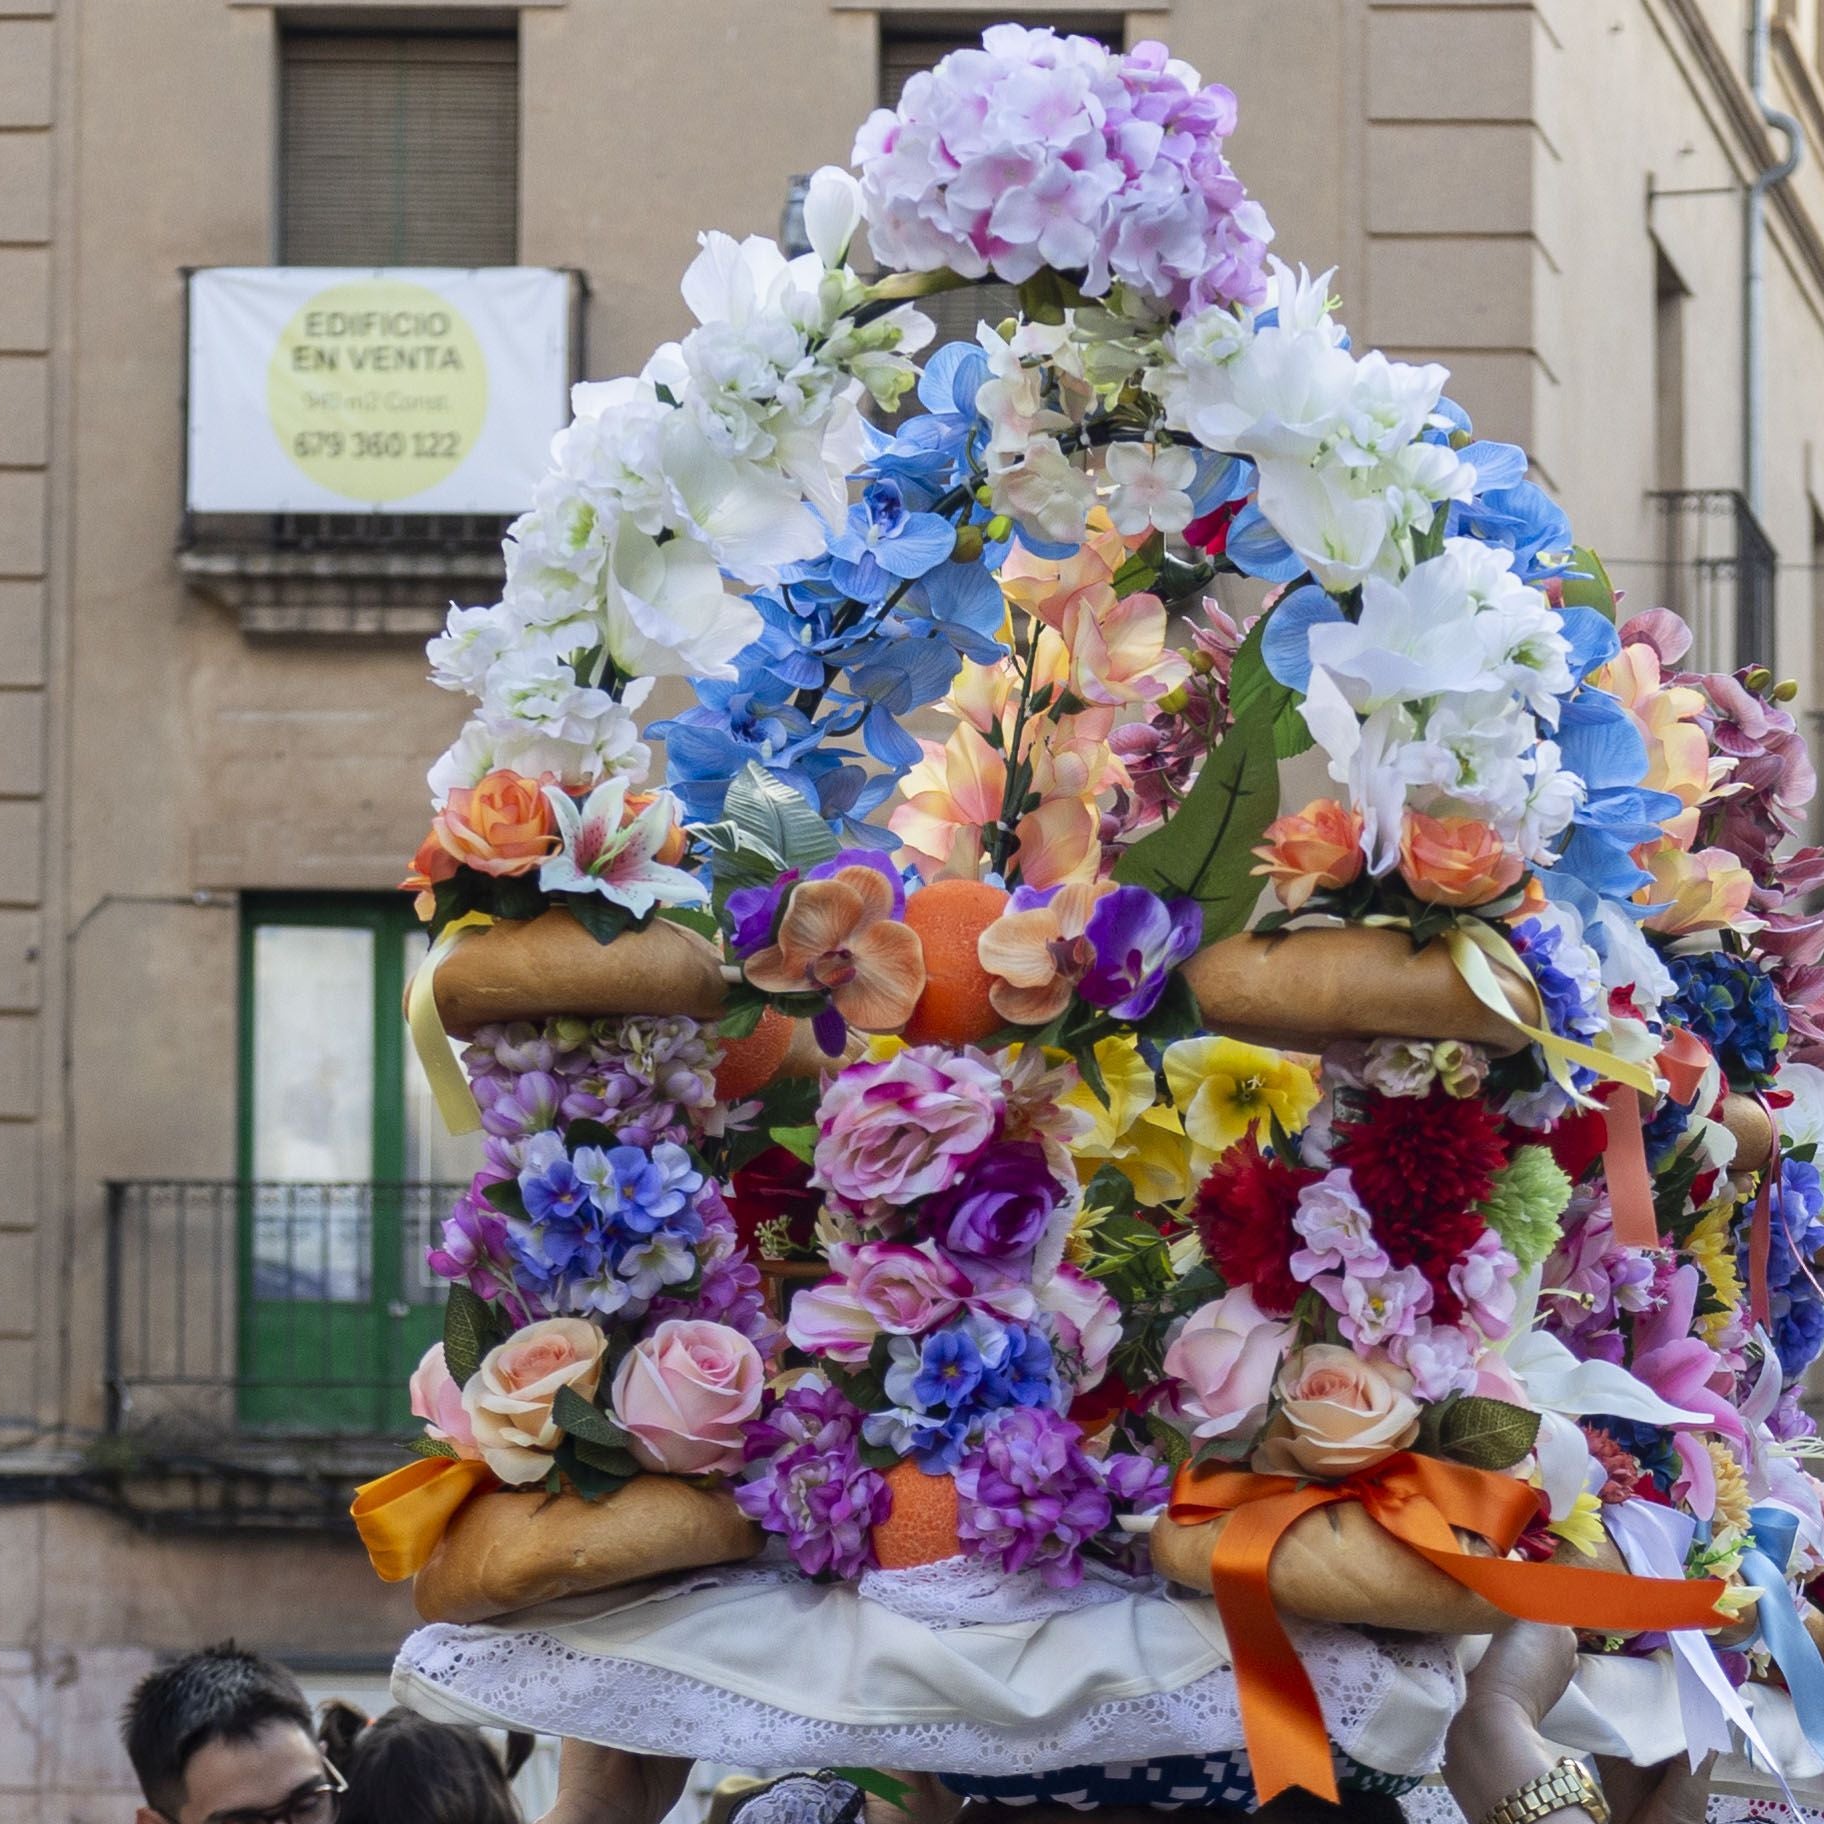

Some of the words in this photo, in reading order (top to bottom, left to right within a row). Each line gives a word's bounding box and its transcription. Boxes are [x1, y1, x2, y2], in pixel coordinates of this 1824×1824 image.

[304, 311, 452, 338] EDIFICIO
[293, 345, 339, 371] EN
[347, 344, 464, 371] VENTA
[293, 430, 346, 458] 679
[351, 430, 406, 458] 360
[412, 430, 462, 458] 122
